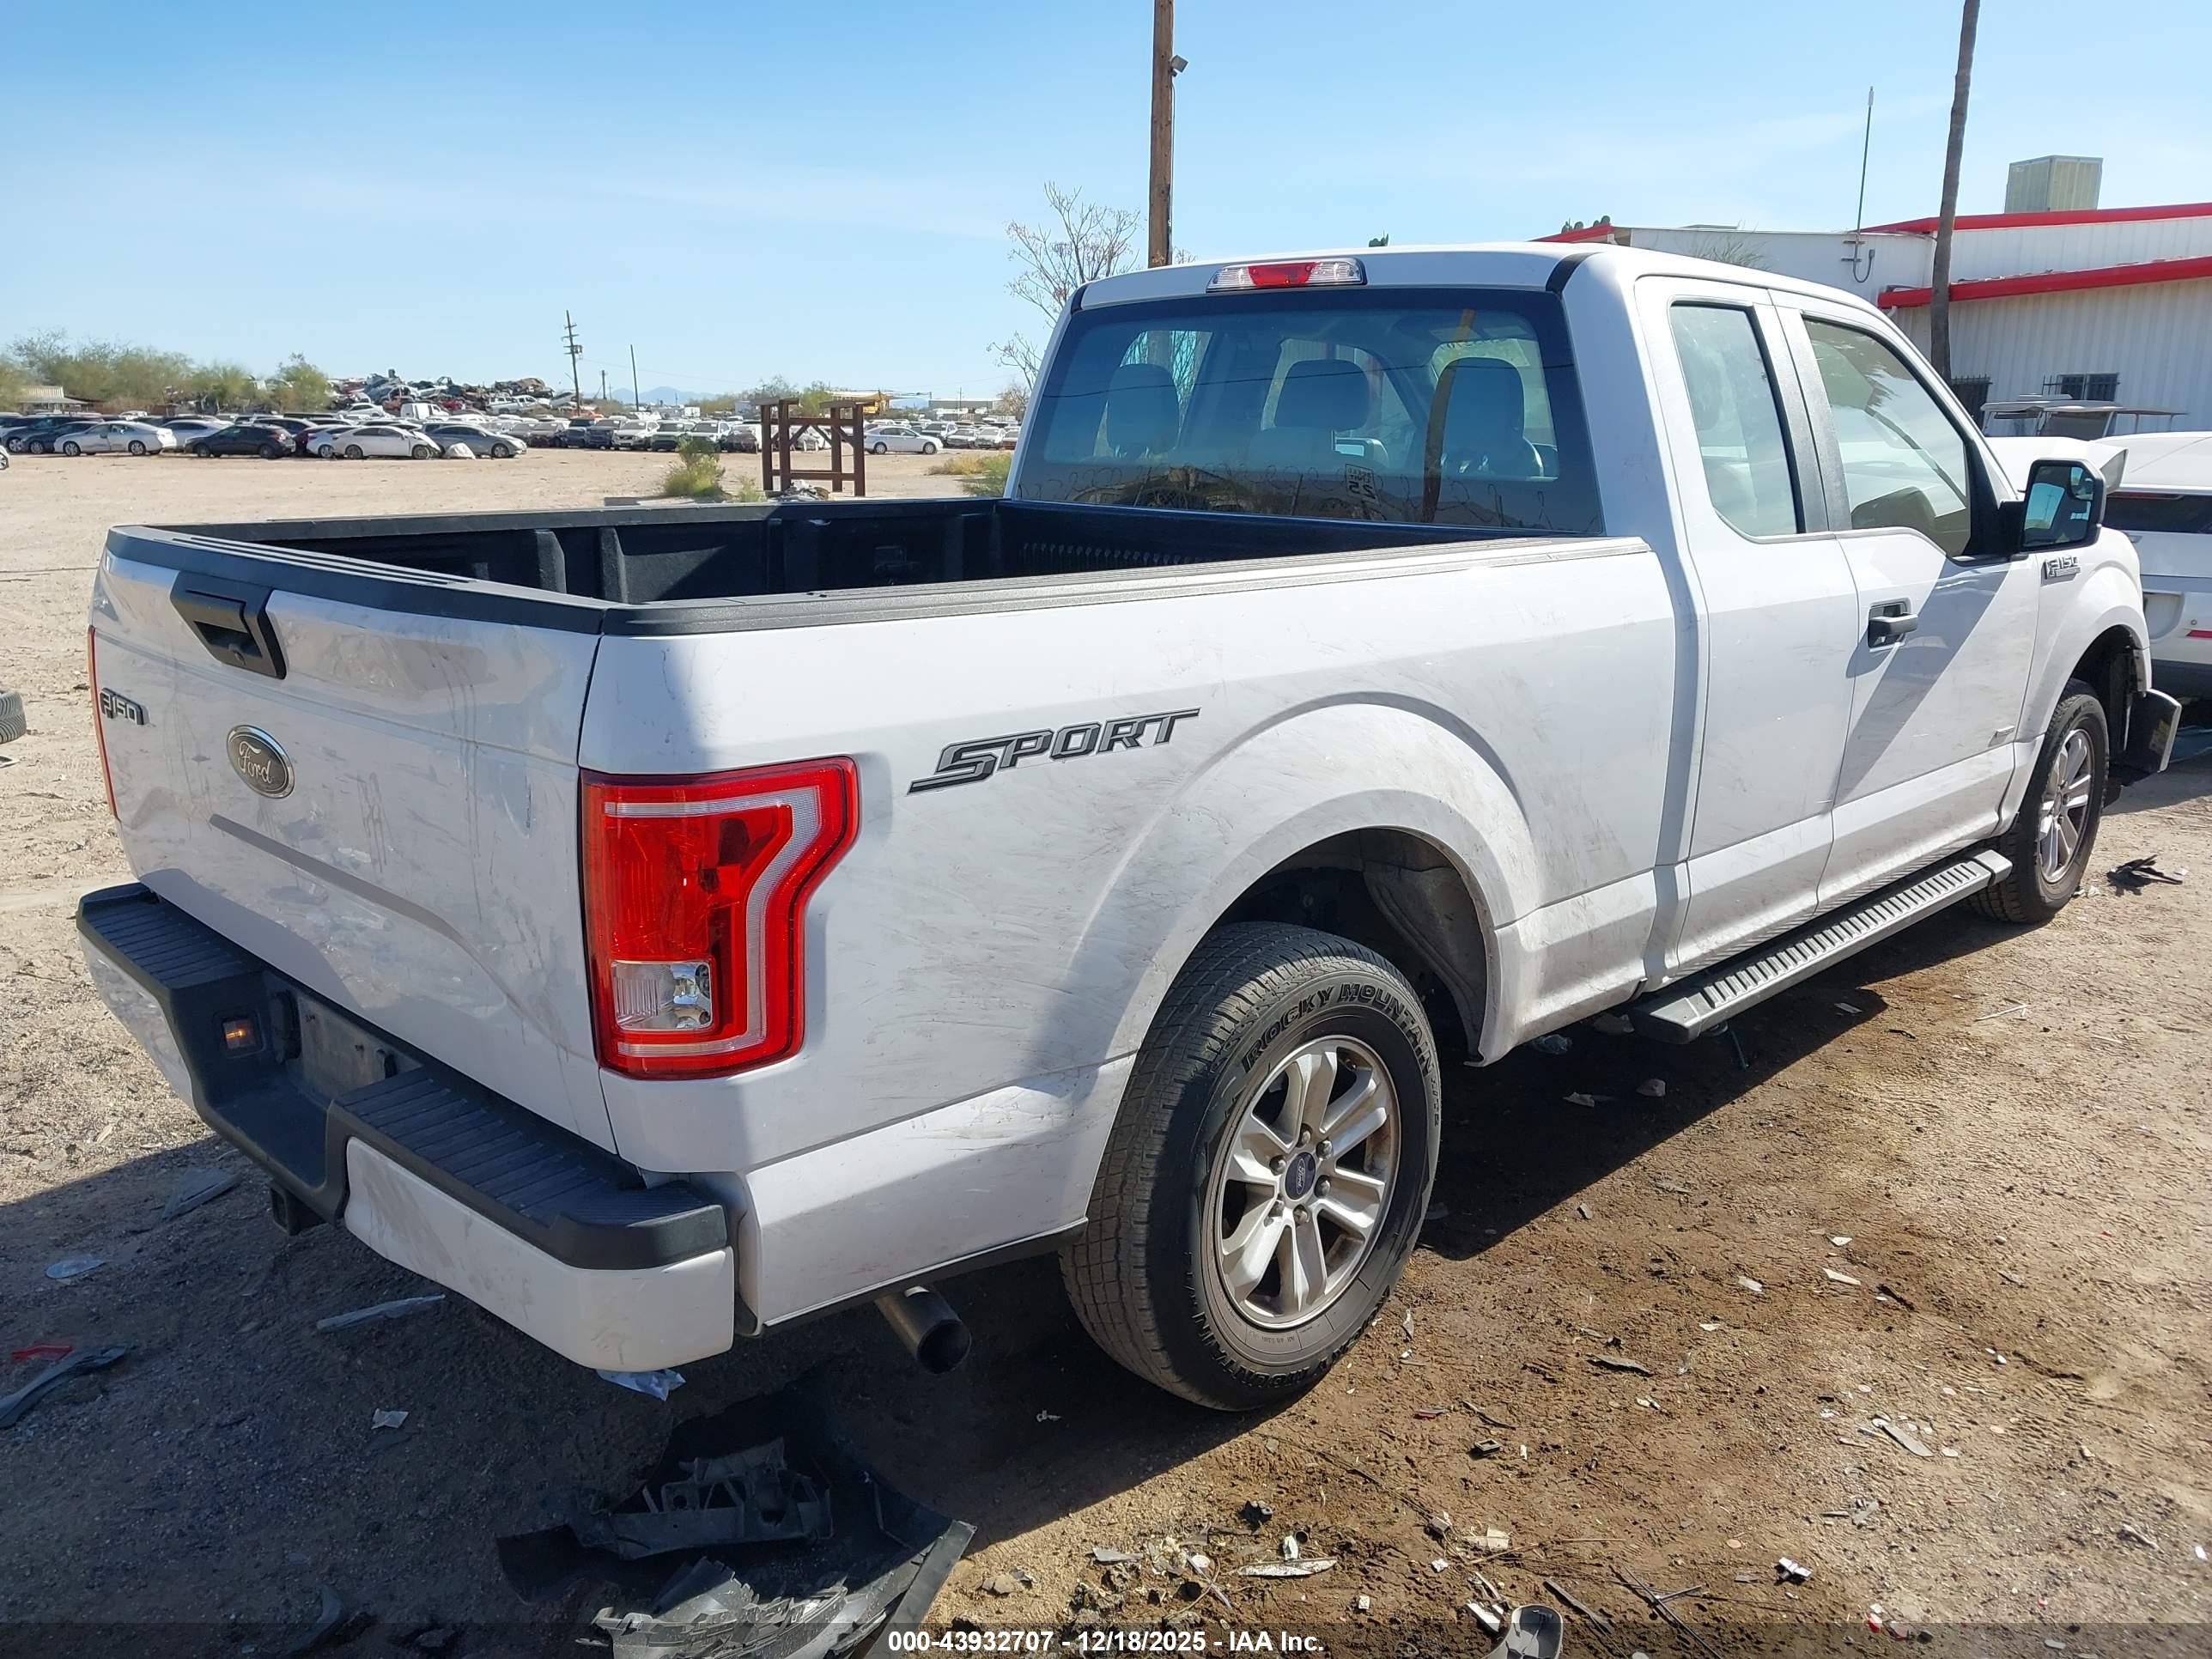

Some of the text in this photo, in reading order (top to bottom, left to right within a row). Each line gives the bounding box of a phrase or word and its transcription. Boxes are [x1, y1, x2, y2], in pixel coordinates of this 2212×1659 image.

[238, 740, 273, 784] Ford
[906, 706, 1202, 795] SPORT
[1244, 982, 1434, 1077] ROCKY MOUNTAIN
